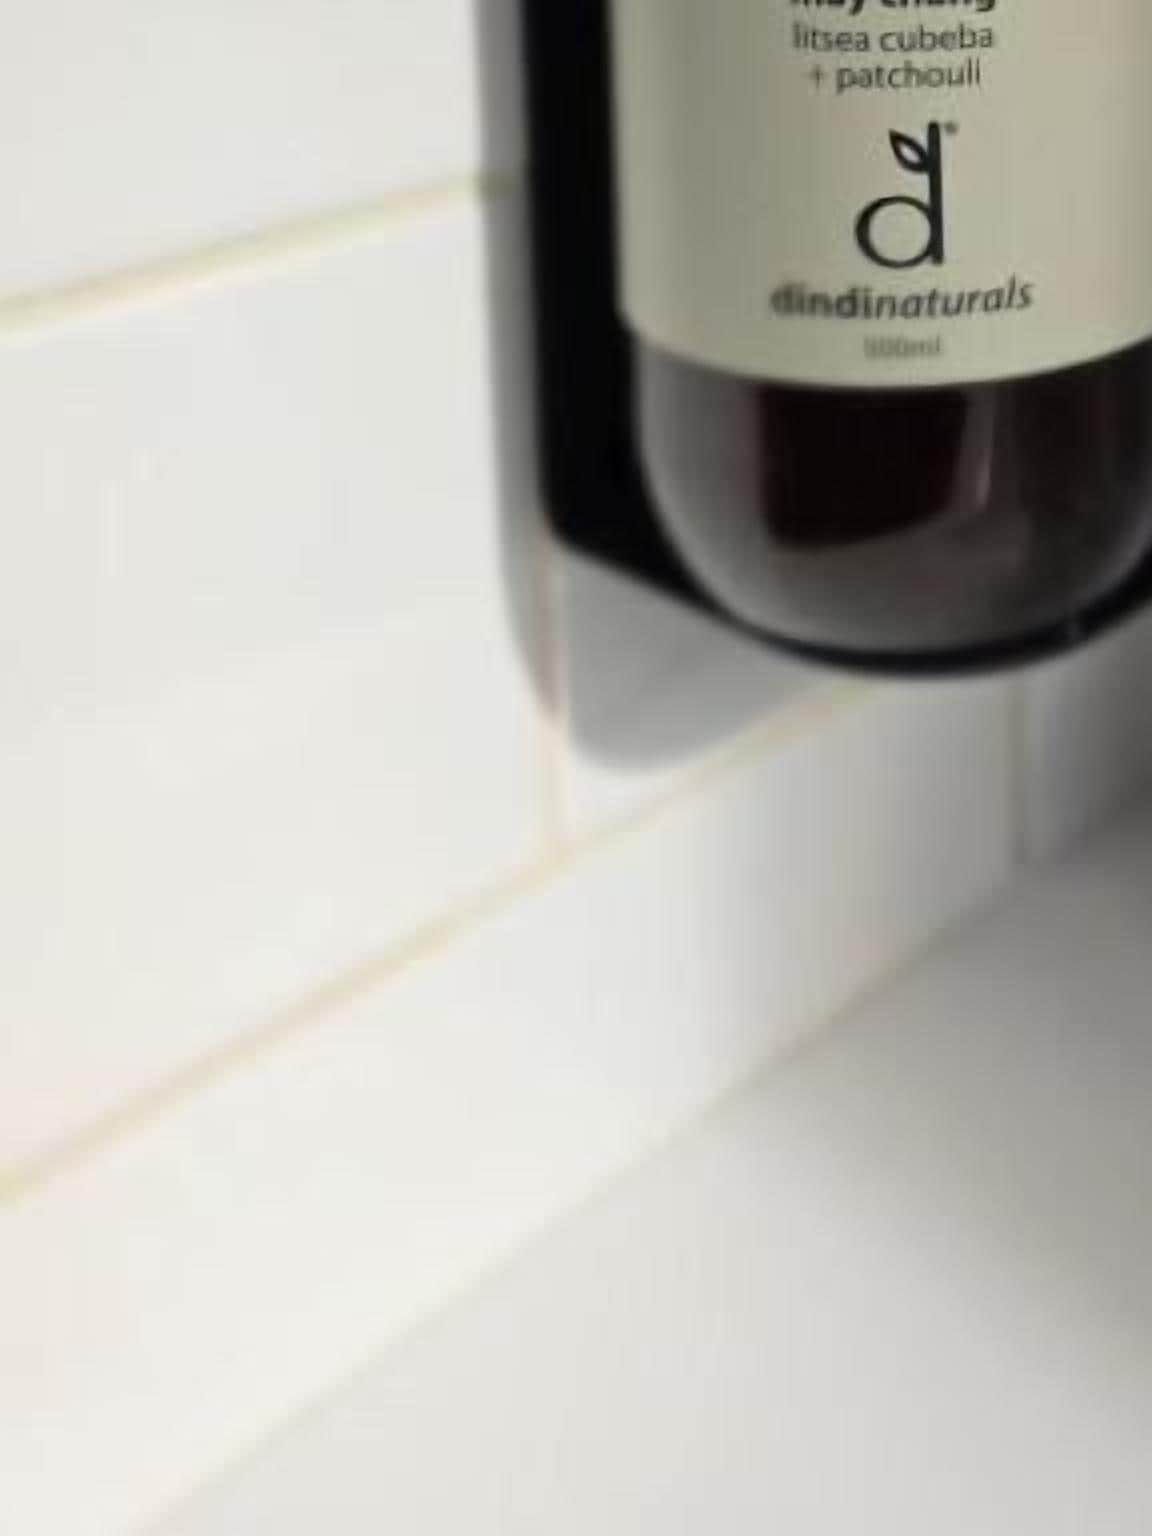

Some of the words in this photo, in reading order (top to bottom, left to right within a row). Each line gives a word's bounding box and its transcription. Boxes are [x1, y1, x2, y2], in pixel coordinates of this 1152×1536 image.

[792, 22, 870, 52] litsea
[880, 24, 994, 52] cubeba
[836, 60, 982, 92] patchouli
[770, 275, 1036, 320] dindinaturals
